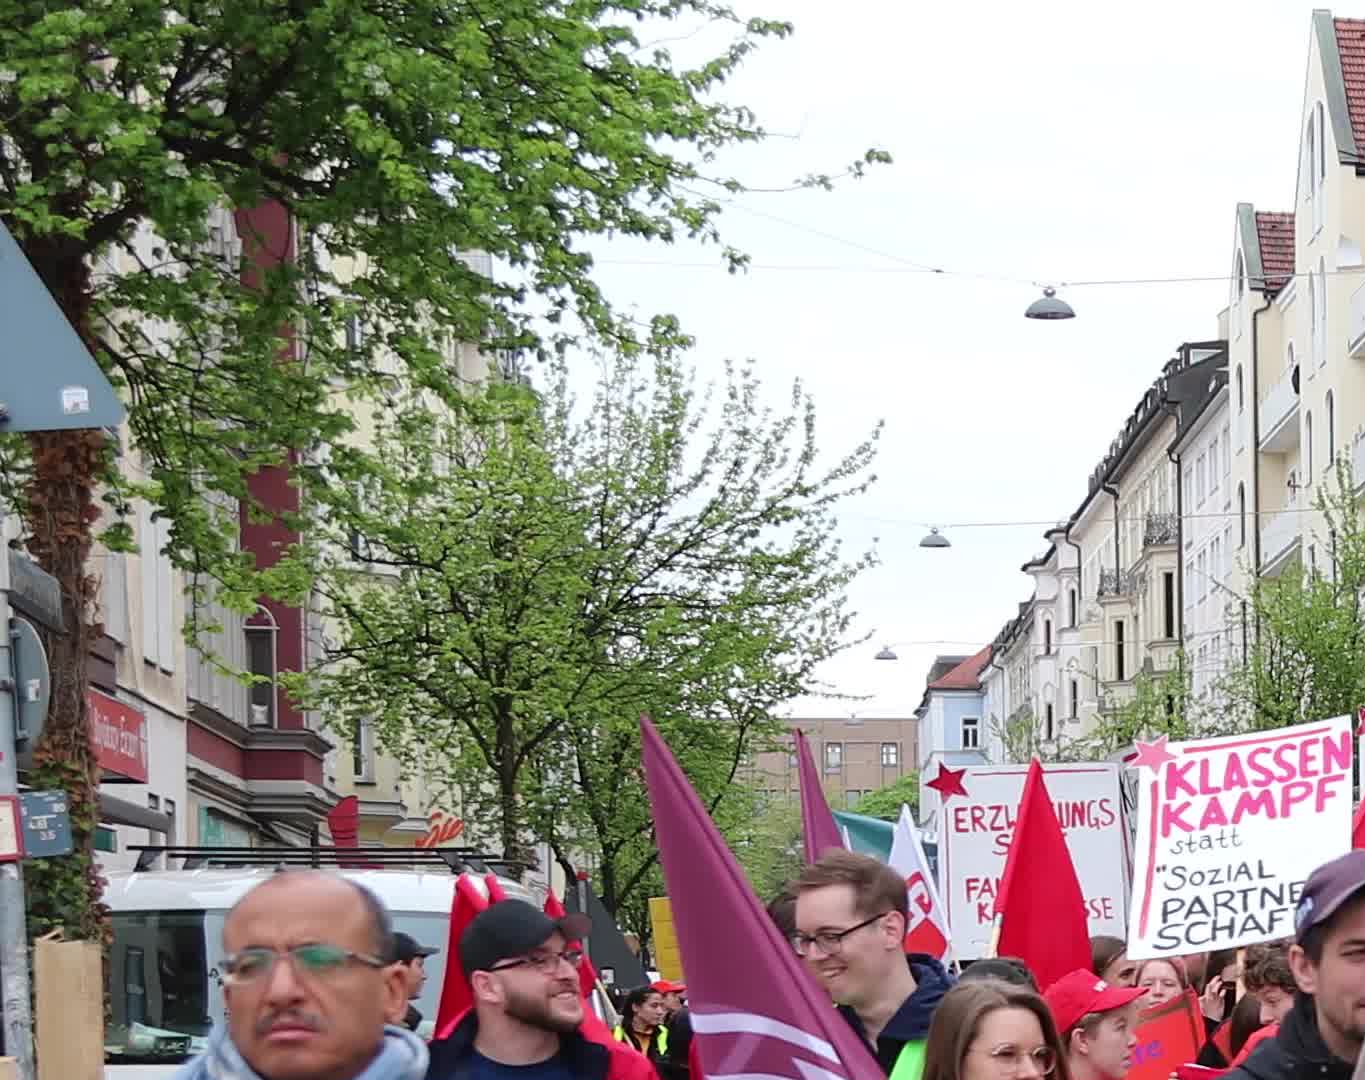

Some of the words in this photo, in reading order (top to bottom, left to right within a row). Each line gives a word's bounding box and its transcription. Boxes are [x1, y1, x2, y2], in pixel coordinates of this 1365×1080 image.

[1165, 730, 1352, 800] KLASSEN
[1161, 774, 1345, 838] KAMPF
[1170, 826, 1243, 855] statt
[1161, 880, 1305, 924] PARTNE
[1152, 907, 1299, 950] SCHAF
